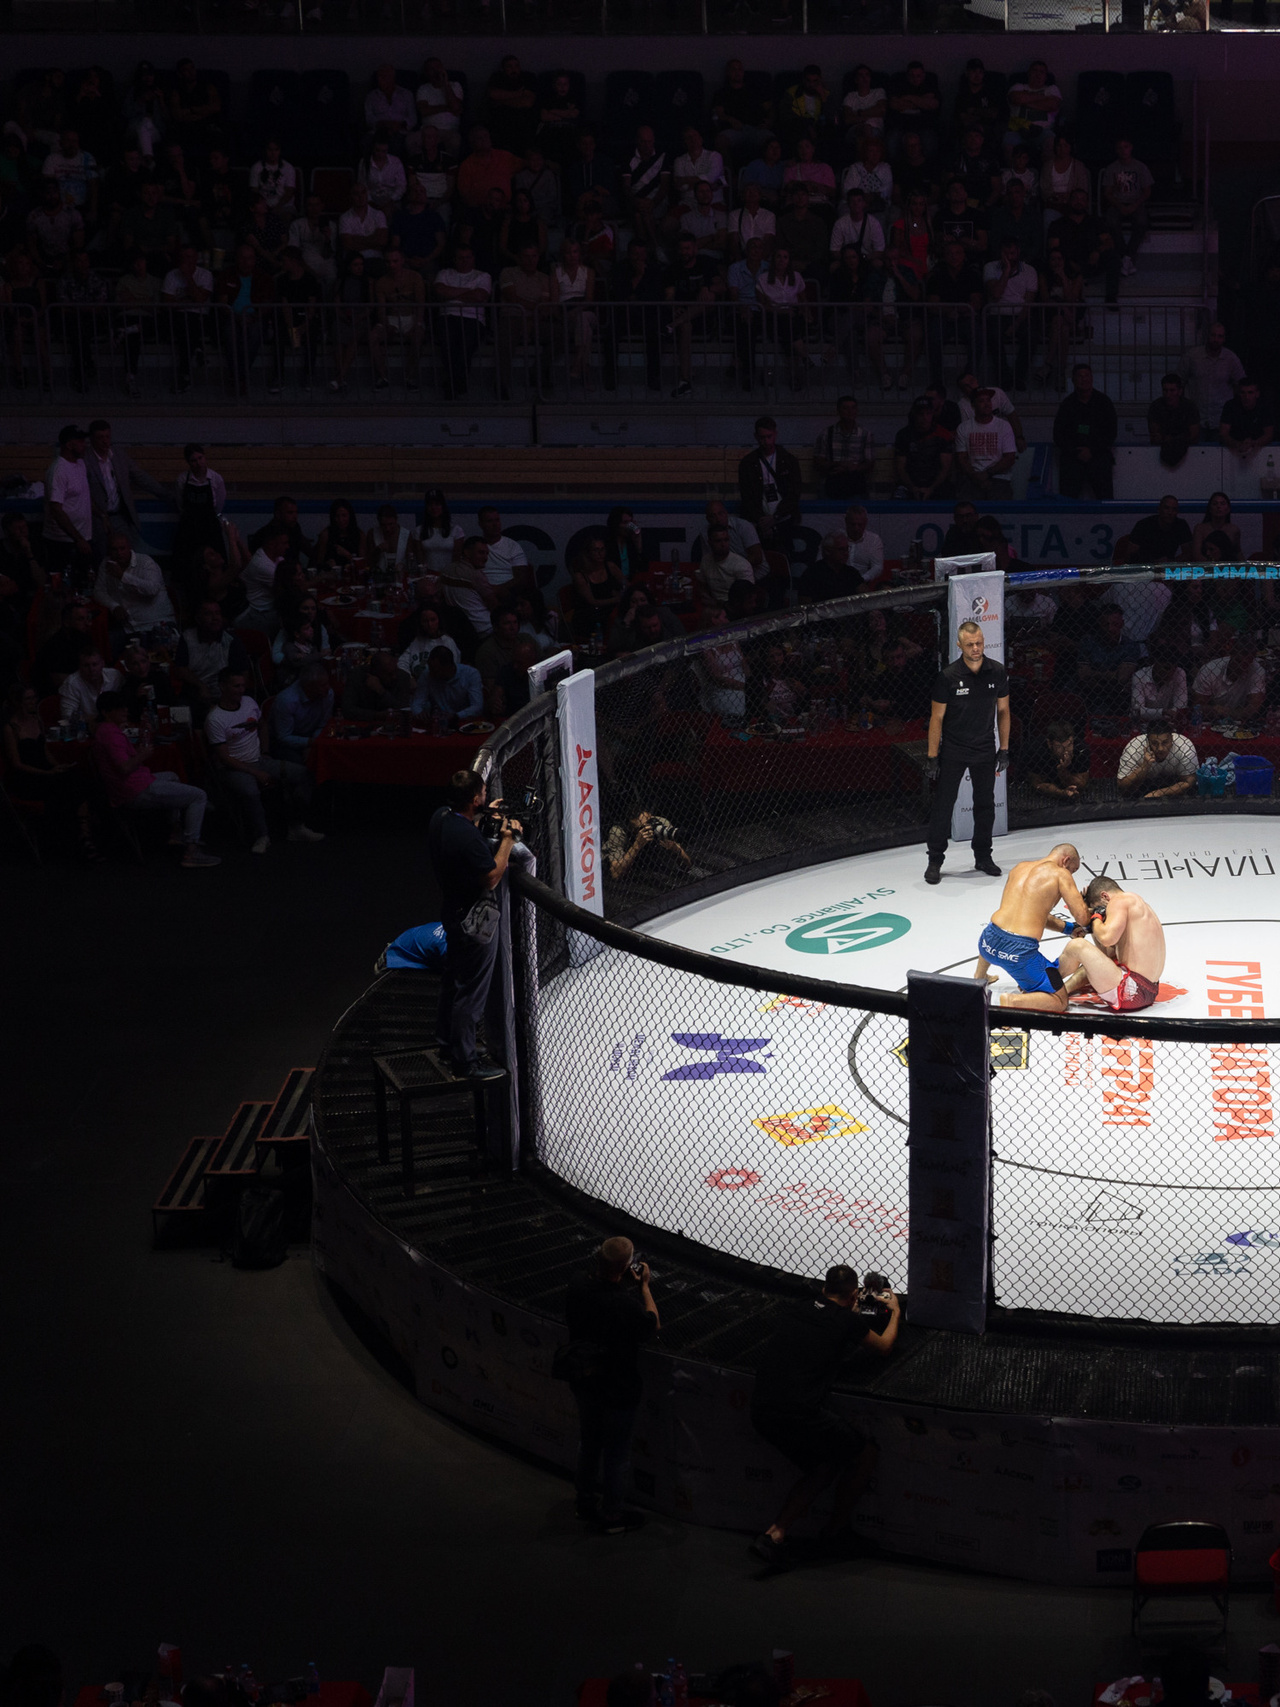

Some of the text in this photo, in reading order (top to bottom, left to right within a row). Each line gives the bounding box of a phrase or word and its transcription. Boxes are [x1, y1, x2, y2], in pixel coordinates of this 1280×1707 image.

[1080, 854, 1276, 881] ПЛАНЕТА
[791, 887, 896, 924] SV-Alliance
[1205, 959, 1275, 1142] ГУБЕНАТОРА
[1174, 1266, 1251, 1276] LADA
